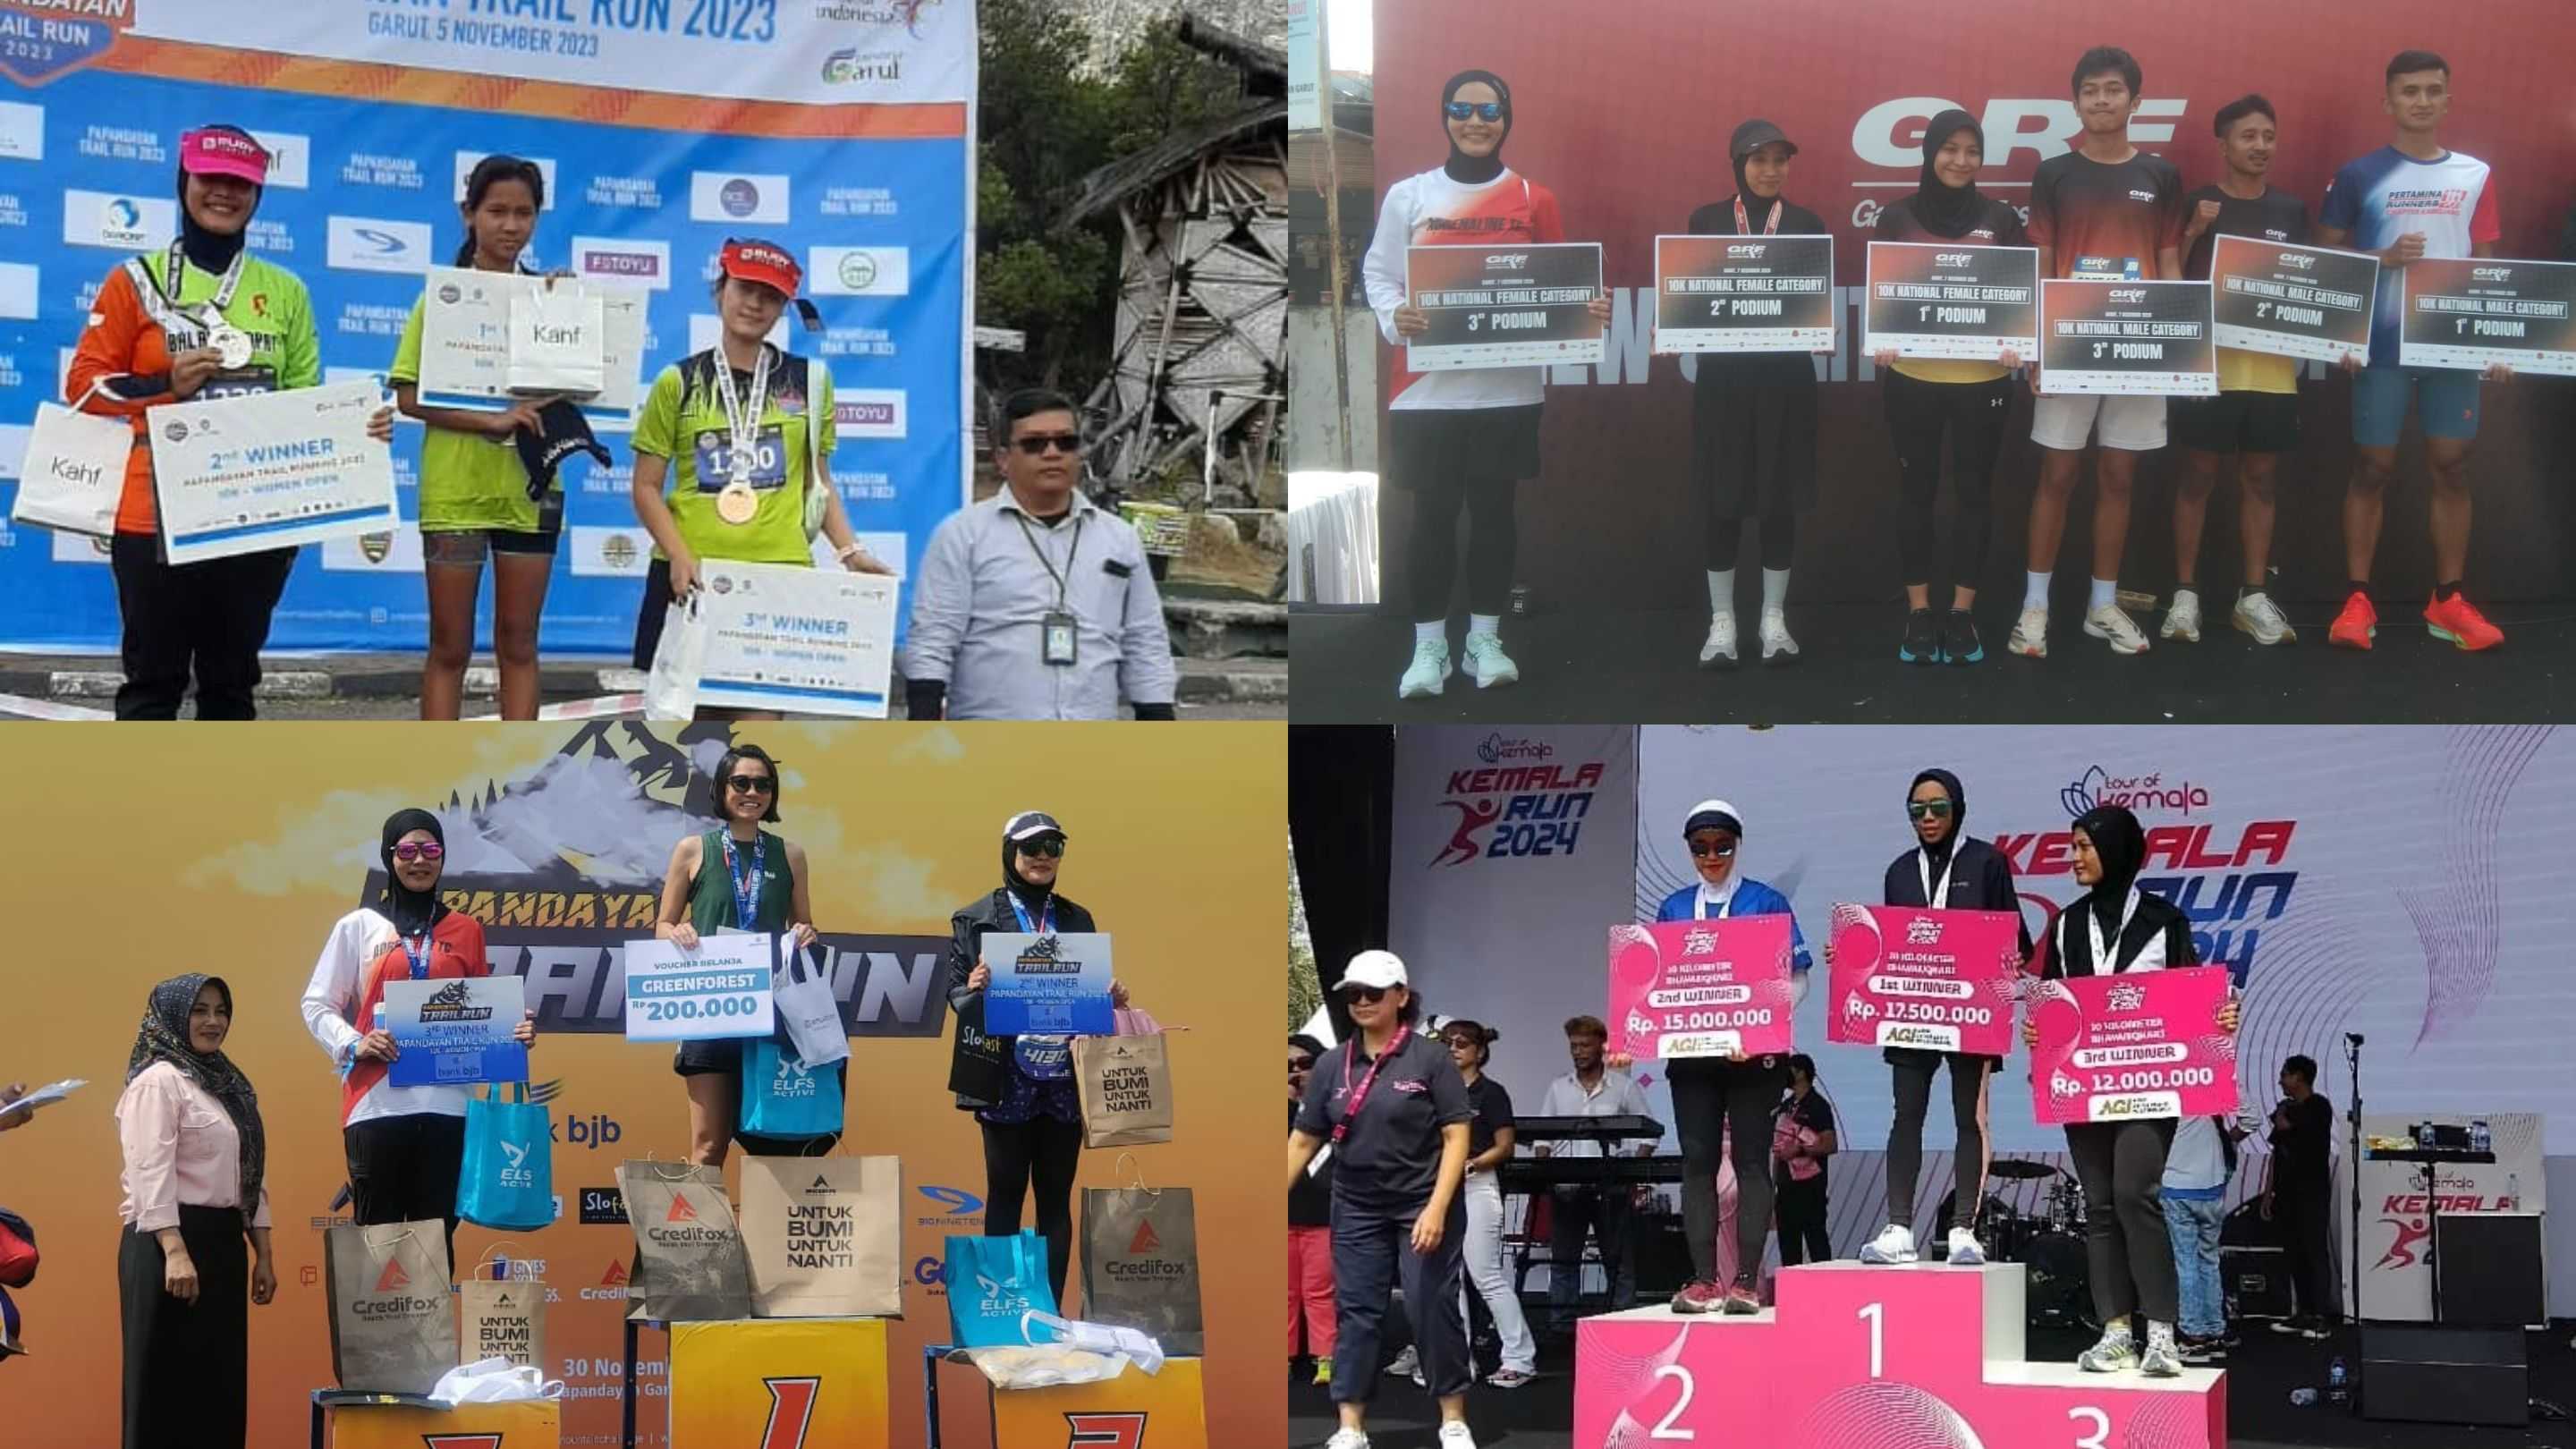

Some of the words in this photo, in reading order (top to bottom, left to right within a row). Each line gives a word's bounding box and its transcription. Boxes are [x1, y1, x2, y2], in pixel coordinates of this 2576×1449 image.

[683, 0, 776, 42] 2023
[42, 21, 90, 47] RUN
[436, 16, 449, 41] 5
[453, 20, 552, 53] NOVEMBER
[556, 32, 599, 58] 2023
[5, 41, 54, 60] 2023
[1852, 97, 2188, 168] GRF
[2387, 190, 2442, 199] PERTAMINA
[1668, 279, 1685, 292] 10K
[1688, 279, 1733, 292] NATIONAL
[1736, 279, 1774, 292] FEMALE
[1775, 279, 1823, 292] CATEGORY
[1878, 284, 1895, 297] 10K
[1897, 285, 1941, 299] NATIONAL
[1944, 287, 1979, 301] FEMALE
[1982, 288, 2028, 301] CATEGORY
[2225, 278, 2242, 291] 10K
[2243, 281, 2285, 297] NATIONAL
[2288, 287, 2314, 301] MALE
[2315, 290, 2360, 309] CATEGORY
[1419, 292, 1439, 307] 10K
[1443, 292, 1493, 306] NATIONAL
[1496, 290, 1538, 304] FEMALE
[1540, 288, 1591, 303] CATEGORY
[1732, 300, 1782, 316] PODIUM
[1936, 307, 1986, 324] PODIUM
[2275, 305, 2323, 326] PODIUM
[2419, 298, 2436, 309] 10K
[2438, 298, 2483, 312] NATIONAL
[2486, 300, 2513, 313] MALE
[2515, 301, 2564, 316] CATEGORY
[1491, 311, 1546, 330] PODIUM
[2057, 322, 2074, 335] 10K
[2077, 322, 2121, 335] NATIONAL
[2123, 323, 2149, 335] MALE
[2152, 324, 2199, 336] CATEGORY
[2474, 319, 2525, 336] PODIUM
[2113, 343, 2163, 360] PODIUM
[837, 405, 886, 420] TOYU
[245, 438, 334, 464] WINNER
[303, 473, 339, 490] OPEN
[772, 614, 849, 636] WINNER
[1445, 763, 1606, 794] KEMALA
[2105, 775, 2140, 789] tour
[2143, 773, 2162, 787] of
[1504, 792, 1594, 821] RUN
[2096, 781, 2209, 816] kemala
[1487, 821, 1581, 859] 2024
[1994, 820, 2297, 876] KEALA
[654, 960, 699, 970] VOUCHER
[1016, 963, 1053, 974] TRAIL
[1054, 962, 1080, 973] RUN
[641, 973, 757, 994] GREENFOREST
[1036, 978, 1079, 987] WINNER
[1879, 978, 1899, 990] 1st
[1902, 979, 1962, 995] WINNER
[1657, 991, 1681, 1004] 2nd
[1684, 988, 1742, 1002] WINNER
[421, 1011, 462, 1022] TRAIL
[462, 1008, 491, 1021] RUN
[647, 996, 758, 1021] 200.000
[1849, 999, 1880, 1021] Rp.
[1885, 1002, 1991, 1024] 17.500.000
[443, 1023, 488, 1036] WINNER
[1627, 1016, 1658, 1035] Rp.
[1664, 1009, 1772, 1030] 15.000.000
[2084, 1052, 2106, 1063] 3rd
[2110, 1046, 2176, 1062] WINNER
[1102, 1065, 1148, 1079] UNTUK
[774, 1077, 816, 1090] ELFS
[1103, 1078, 1150, 1092] BUMI
[2052, 1077, 2087, 1098] Rp.
[2091, 1067, 2214, 1091] 12.000.000
[1105, 1089, 1150, 1102] UNTUK
[1106, 1100, 1152, 1113] NANTI
[568, 1114, 621, 1149] bjb
[787, 1205, 852, 1219] UNTUK
[648, 1227, 728, 1241] Credifox
[787, 1220, 853, 1237] BUMI
[787, 1239, 852, 1252] UNTUK
[787, 1254, 852, 1268] NANTI
[1105, 1258, 1185, 1275] Credifox
[352, 1295, 439, 1315] Credifox
[980, 1298, 1030, 1309] ELFS
[480, 1317, 529, 1327] UNTUK
[479, 1327, 530, 1342] BUMI
[1856, 1302, 1883, 1378] 1
[480, 1343, 529, 1352] UNTUK
[564, 1359, 589, 1377] 30
[1650, 1364, 1696, 1441] 2
[2067, 1406, 2111, 1449] 3
